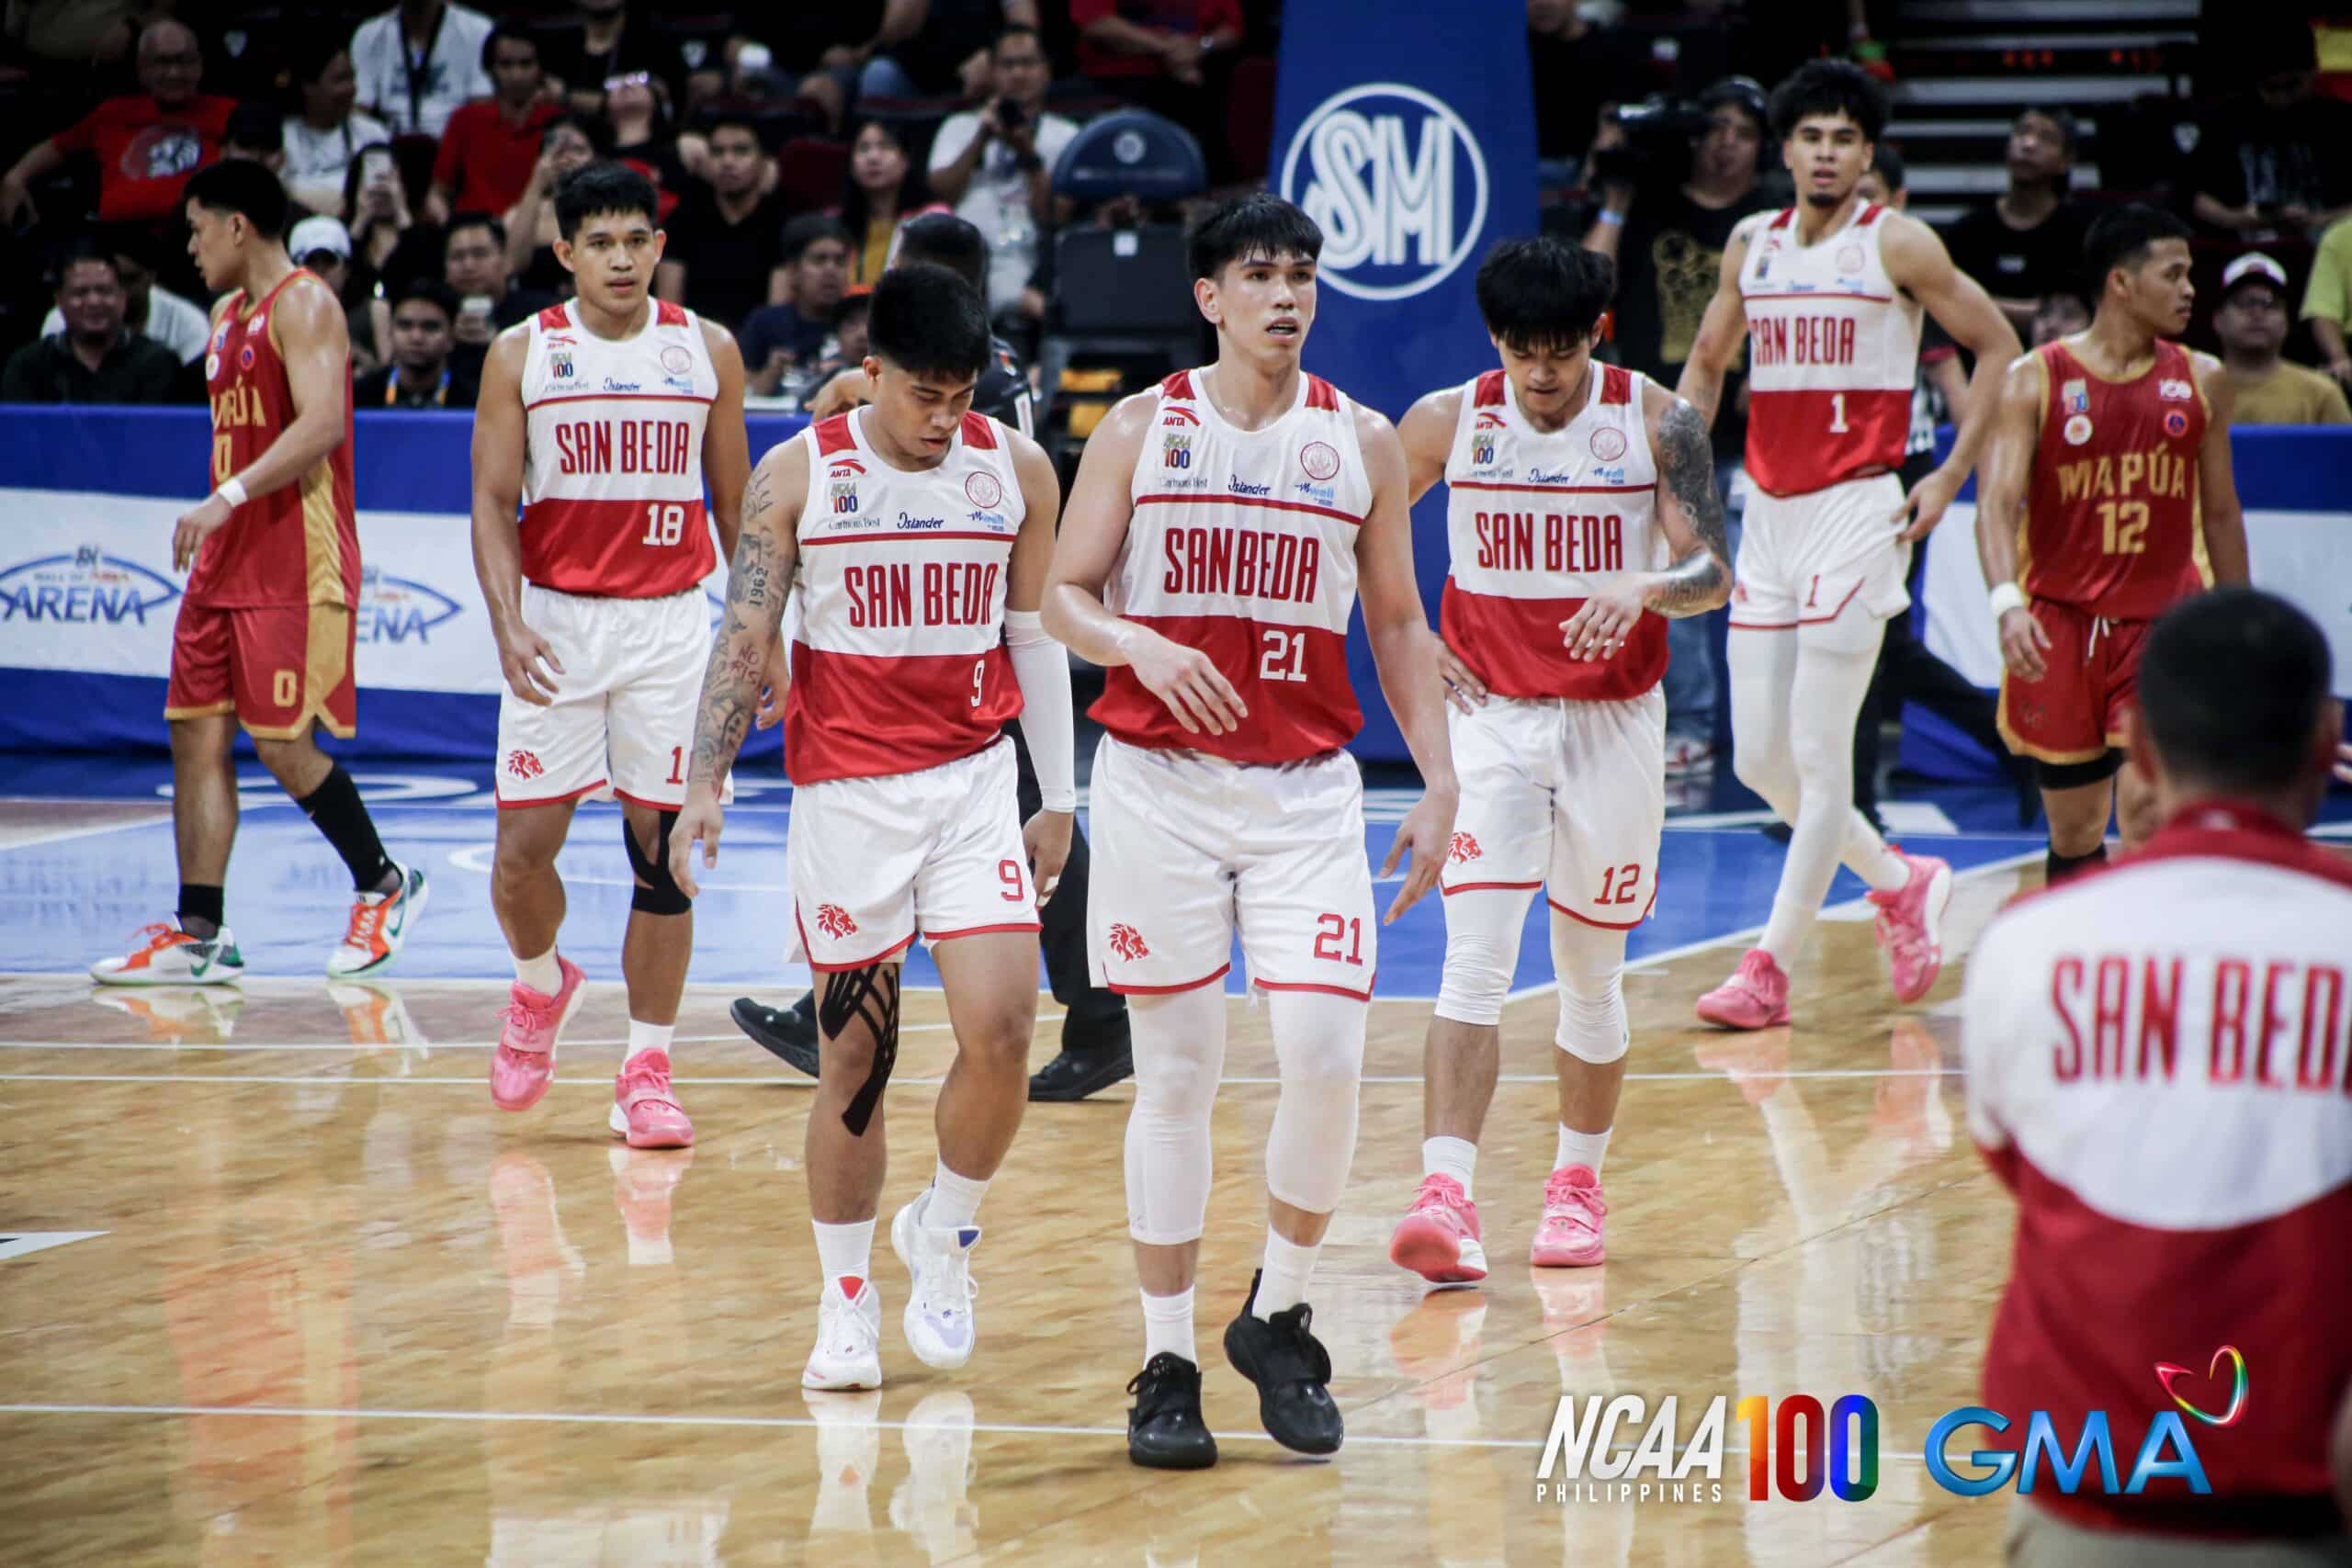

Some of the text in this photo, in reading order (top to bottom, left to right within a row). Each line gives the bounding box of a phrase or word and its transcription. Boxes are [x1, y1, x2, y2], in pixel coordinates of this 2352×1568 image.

[1301, 109, 1454, 269] SM
[1750, 316, 1855, 366] SAN BEDA
[1162, 416, 1185, 426] ANTA
[1829, 393, 1849, 433] 1
[214, 434, 232, 483] 0
[556, 420, 689, 475] SAN BEDA
[1164, 448, 1191, 468] 100
[831, 469, 851, 478] ANTA
[1227, 474, 1271, 495] Islander
[2058, 441, 2186, 505] MAPÚA
[643, 502, 684, 546] 18
[831, 496, 858, 513] 100
[897, 512, 944, 530] Islander
[1476, 513, 1623, 572] SAN BEDA
[2096, 501, 2151, 555] 12
[749, 567, 769, 607] 1962
[1163, 527, 1319, 603] SAN BEDA
[3, 584, 145, 625] ARENA
[844, 563, 999, 627] SAN BEDA
[1804, 574, 1820, 607] 1
[1259, 630, 1307, 682] 21
[273, 670, 297, 706] 0
[971, 660, 985, 706] 9
[999, 859, 1024, 902] 9
[1593, 863, 1640, 905] 12
[1314, 913, 1363, 966] 21
[2049, 955, 2352, 1100] SAN BED
